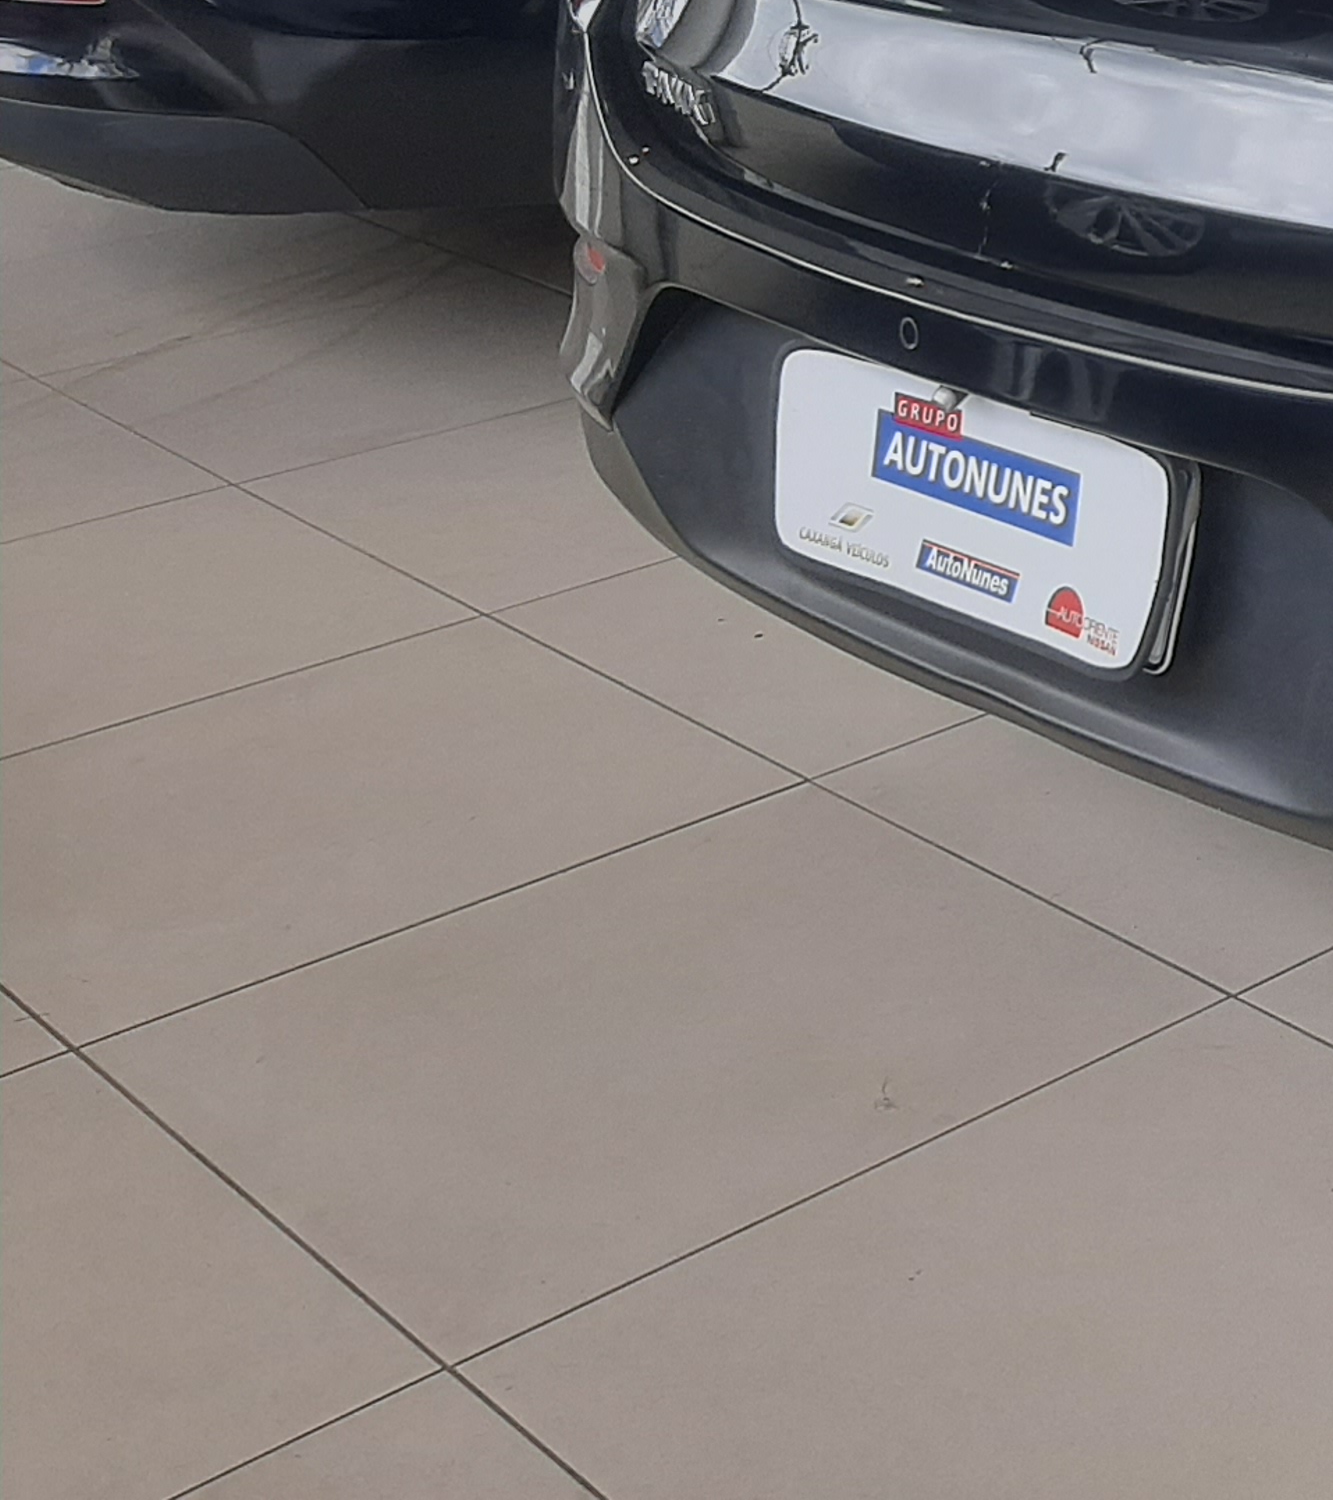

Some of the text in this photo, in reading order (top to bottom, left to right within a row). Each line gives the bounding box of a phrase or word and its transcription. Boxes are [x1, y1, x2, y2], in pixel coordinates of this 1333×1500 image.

[897, 399, 959, 432] GRUPO
[883, 431, 1069, 525] AUTONUNES
[926, 547, 1009, 596] AutoNunes
